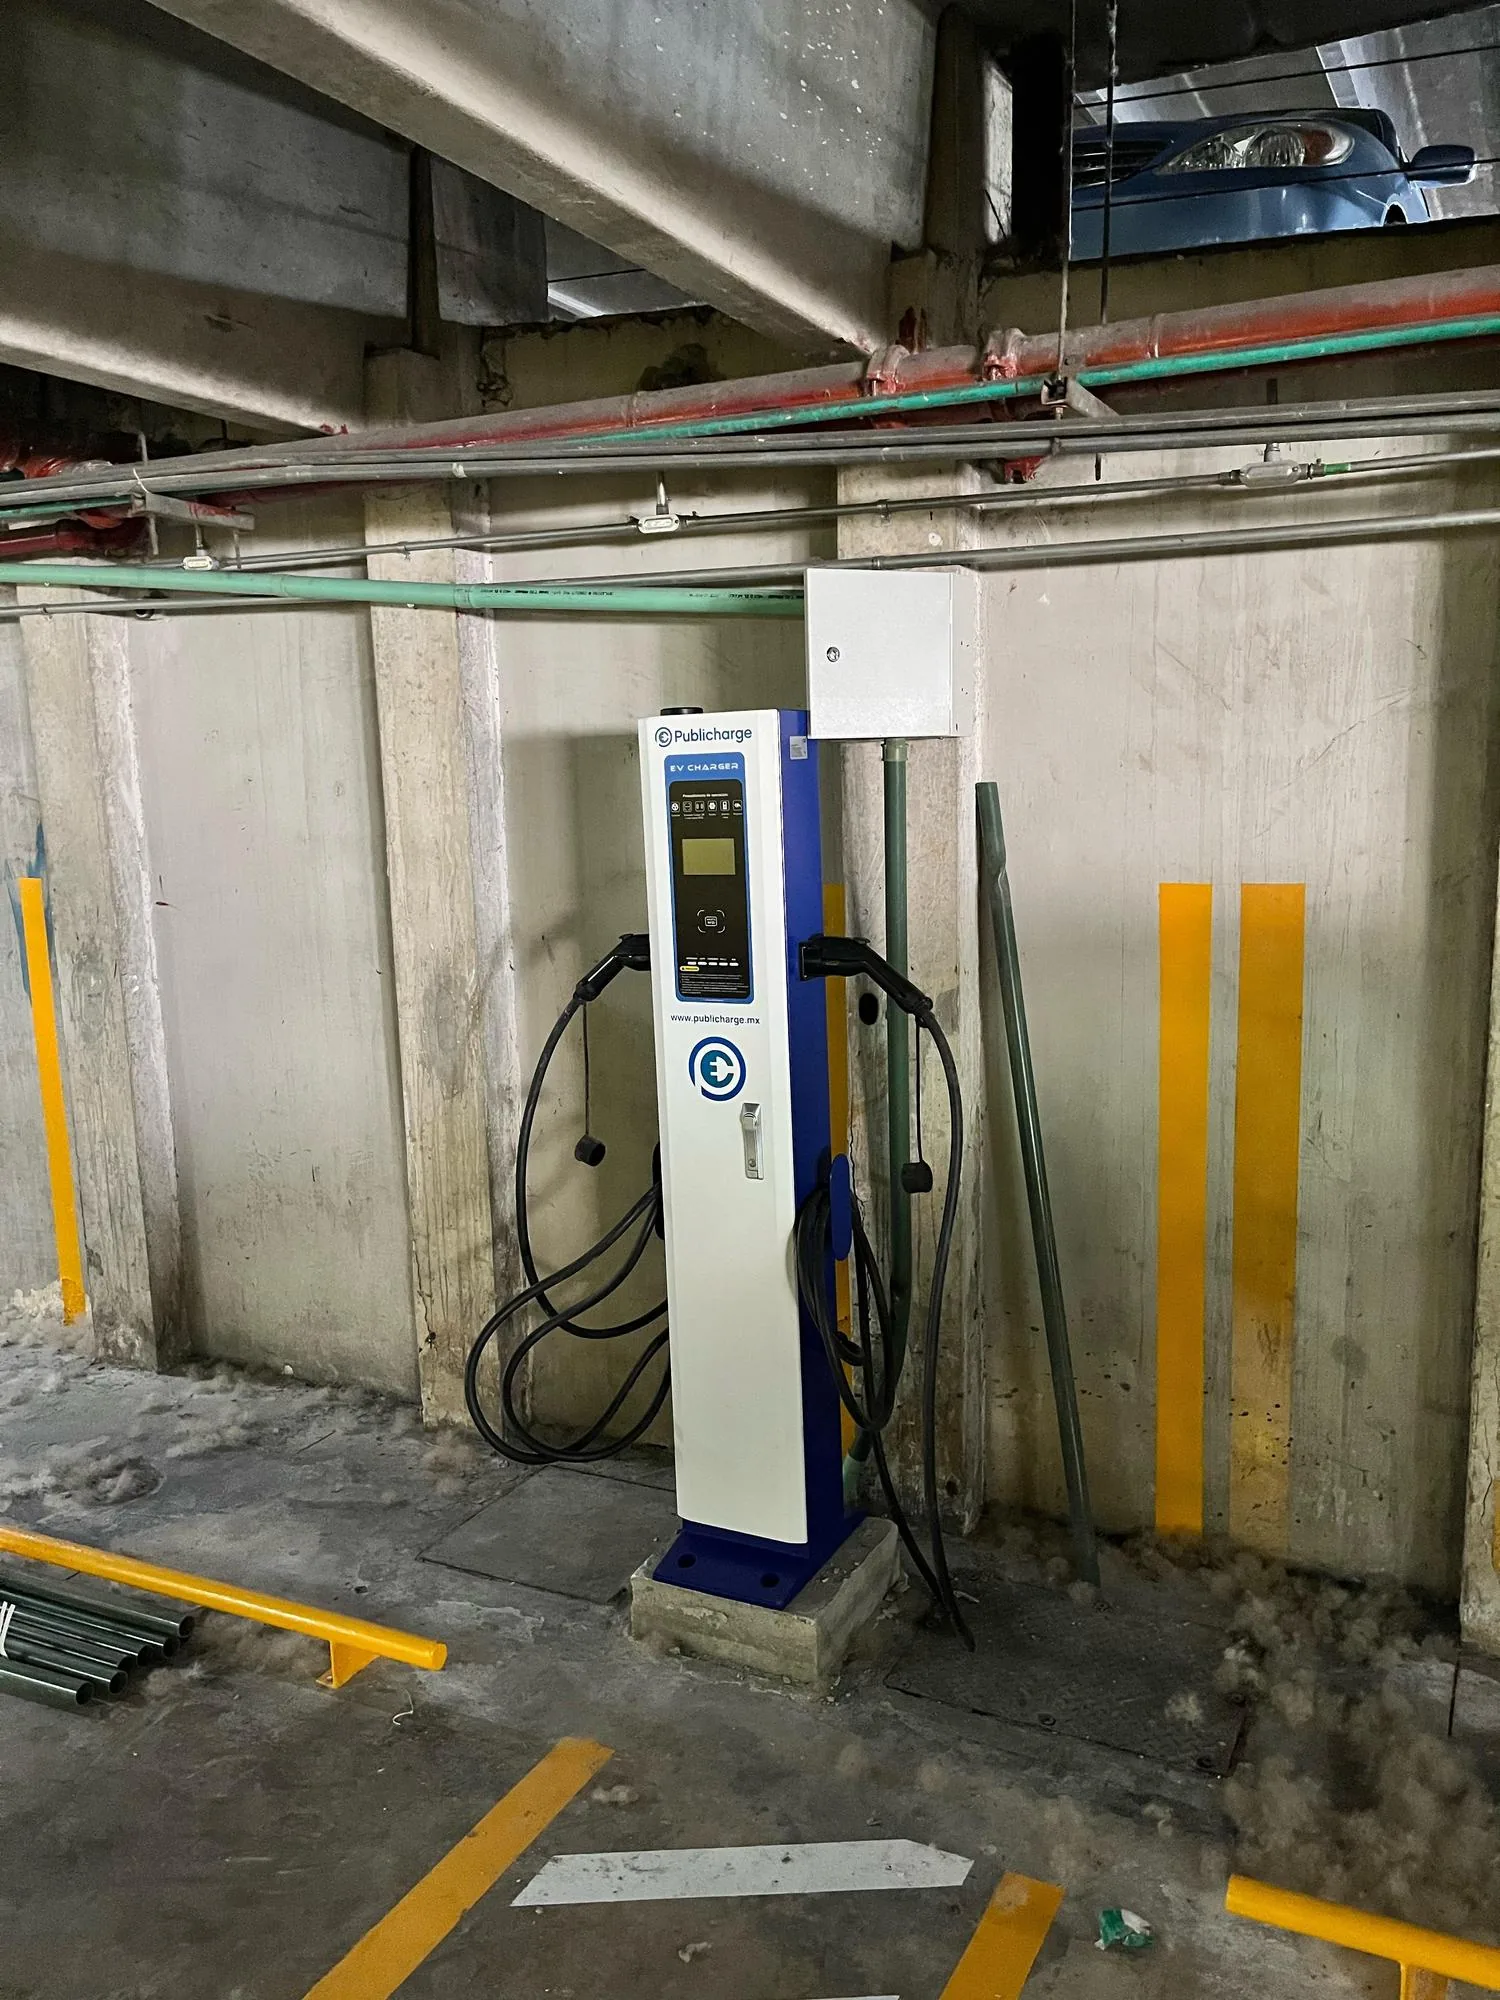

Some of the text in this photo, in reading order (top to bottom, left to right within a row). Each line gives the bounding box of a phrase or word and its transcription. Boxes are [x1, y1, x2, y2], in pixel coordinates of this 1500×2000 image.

[674, 728, 752, 743] Publicharge
[688, 763, 739, 771] CHARGER
[671, 1014, 760, 1026] www.publicharge.mx
